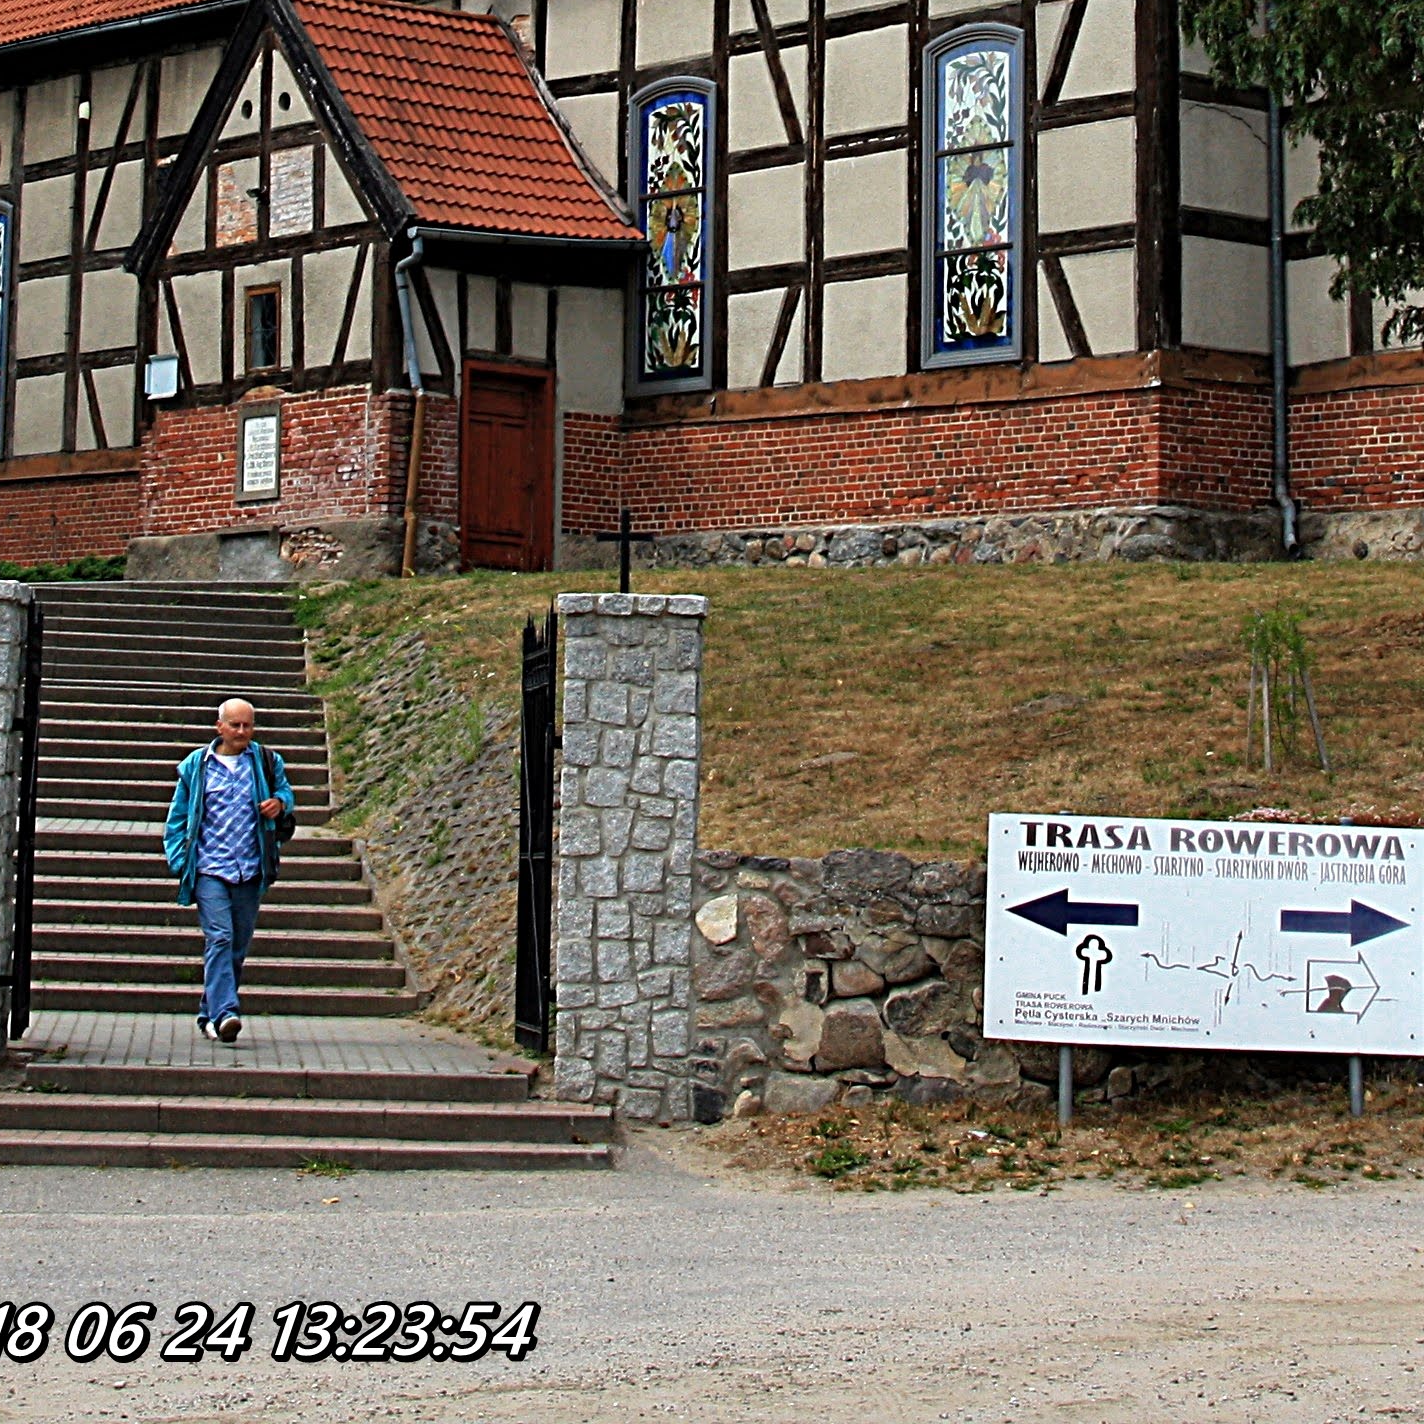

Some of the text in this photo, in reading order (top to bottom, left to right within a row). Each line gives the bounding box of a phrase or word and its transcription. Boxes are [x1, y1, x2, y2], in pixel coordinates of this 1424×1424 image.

[1020, 821, 1405, 861] TRASA ROWEROWA
[1018, 851, 1080, 874] WEJHEROWO
[1091, 853, 1142, 874] MECHOWO
[1154, 855, 1204, 878] STARZYNO
[1278, 857, 1309, 882] DWÓR
[1320, 861, 1375, 885] JASTRZĘBIA
[1379, 860, 1407, 885] GÓRA
[1015, 1000, 1093, 1010] TRASA ROWEROWA
[1044, 1010, 1098, 1022] Cysterska
